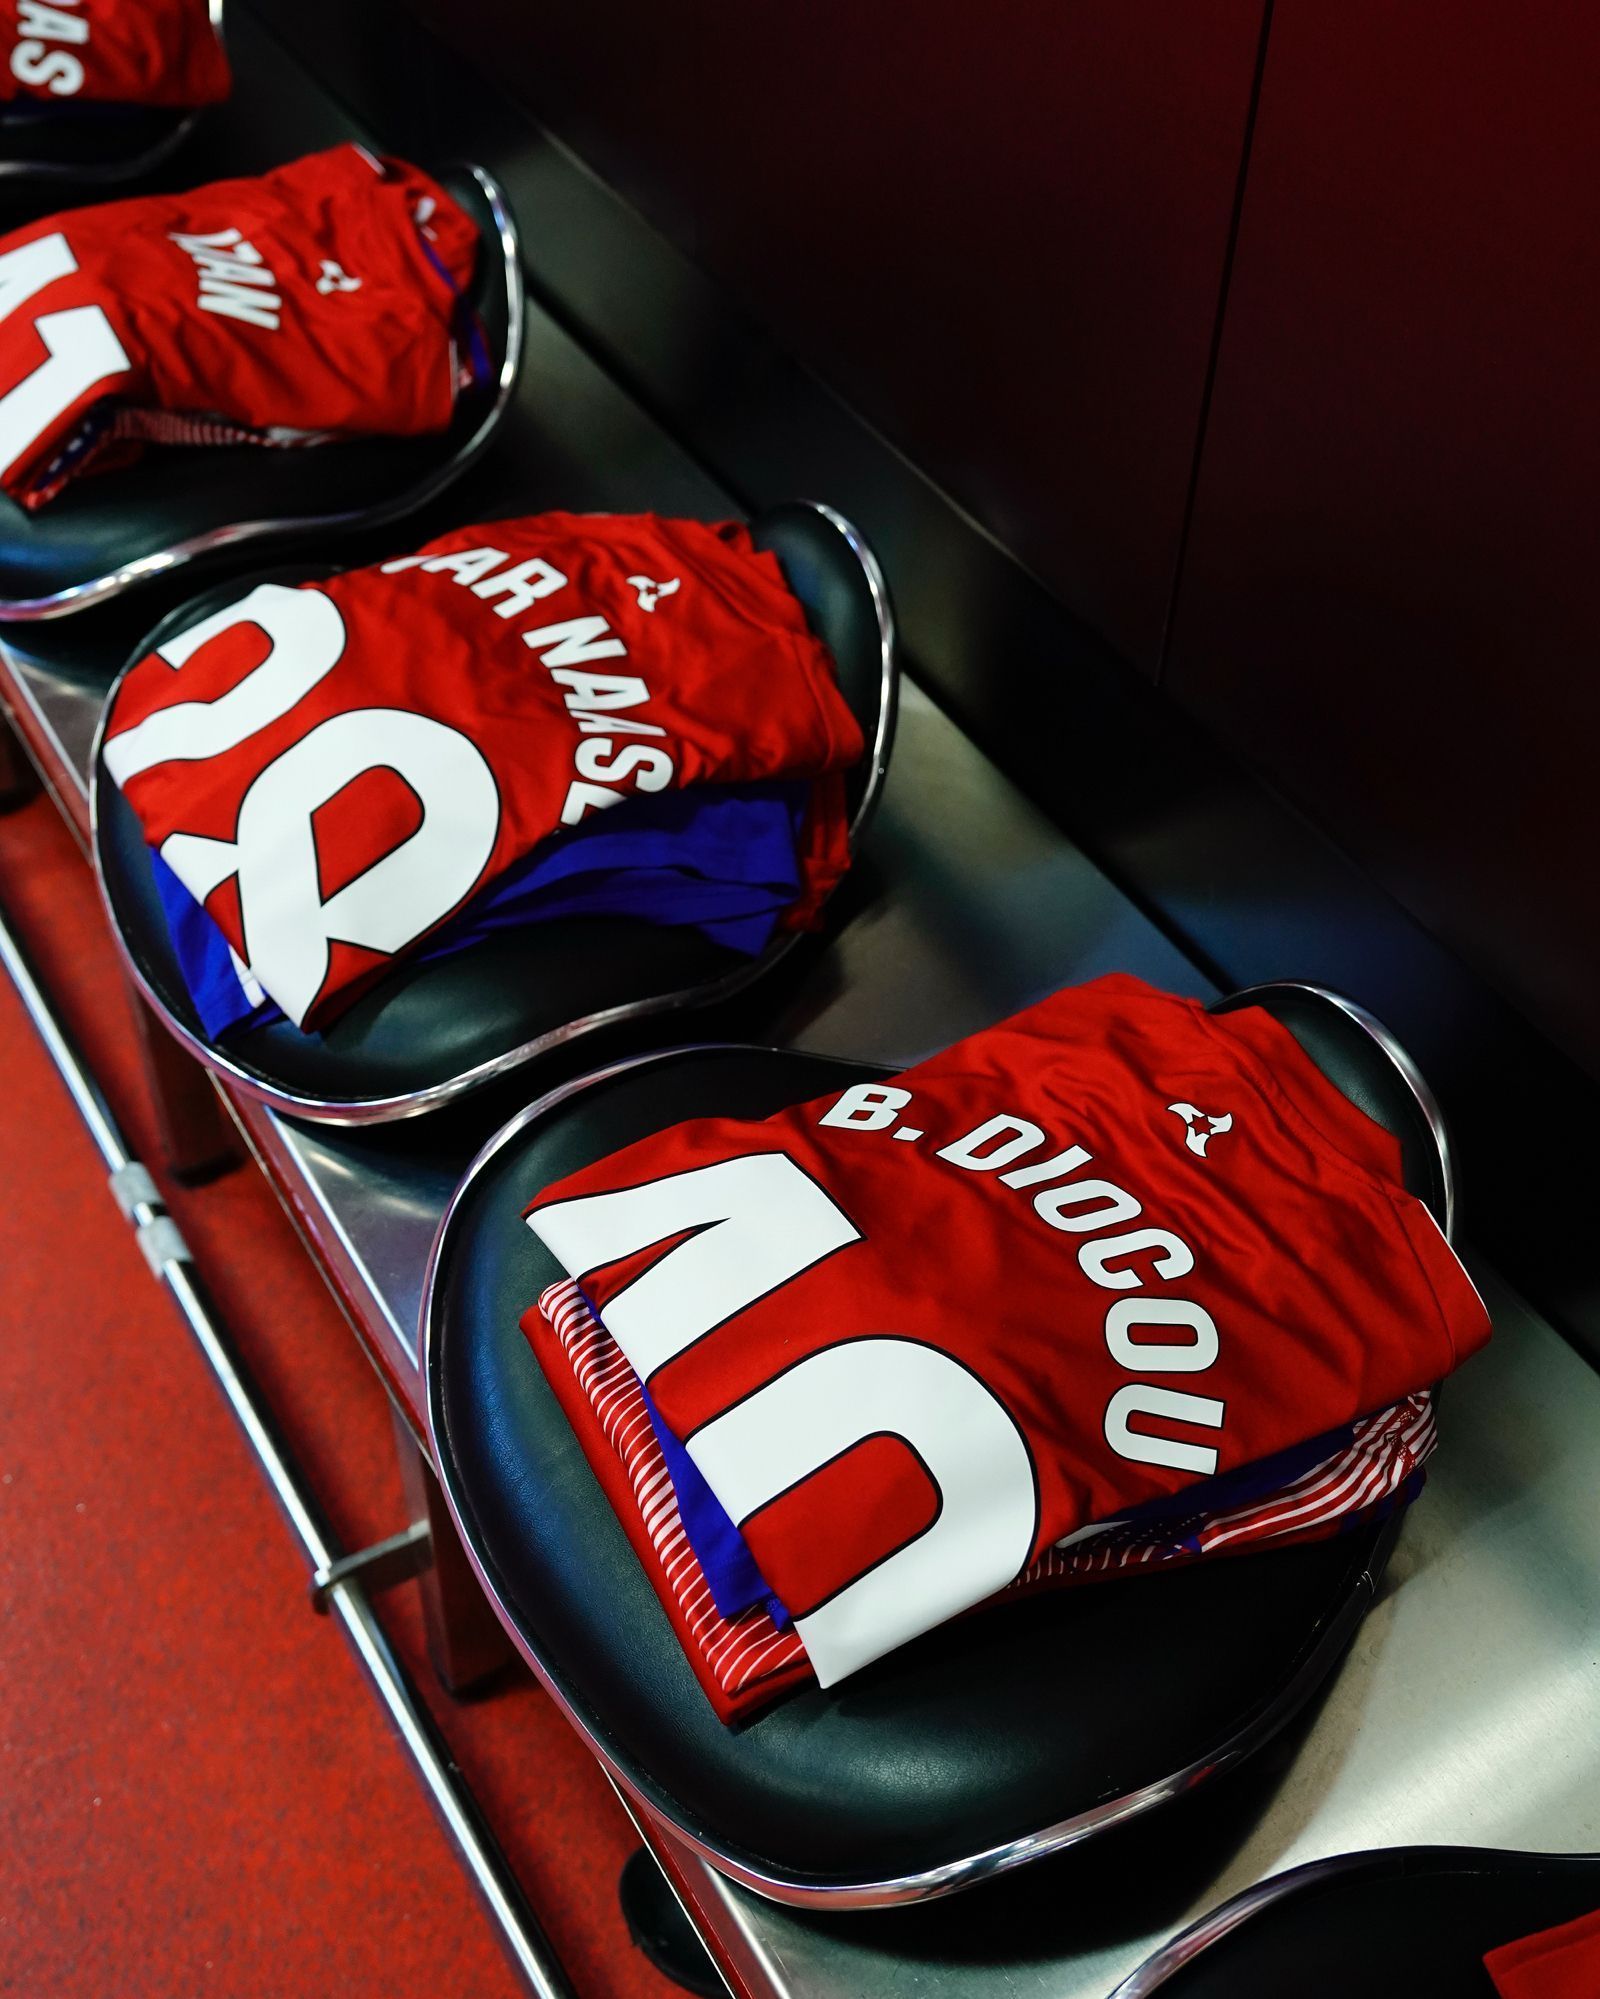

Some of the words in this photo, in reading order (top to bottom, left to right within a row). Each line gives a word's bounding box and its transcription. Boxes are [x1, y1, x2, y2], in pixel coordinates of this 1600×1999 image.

[10, 0, 89, 96] AS
[818, 1083, 925, 1142] B.
[935, 1113, 1229, 1475] DIOCOU
